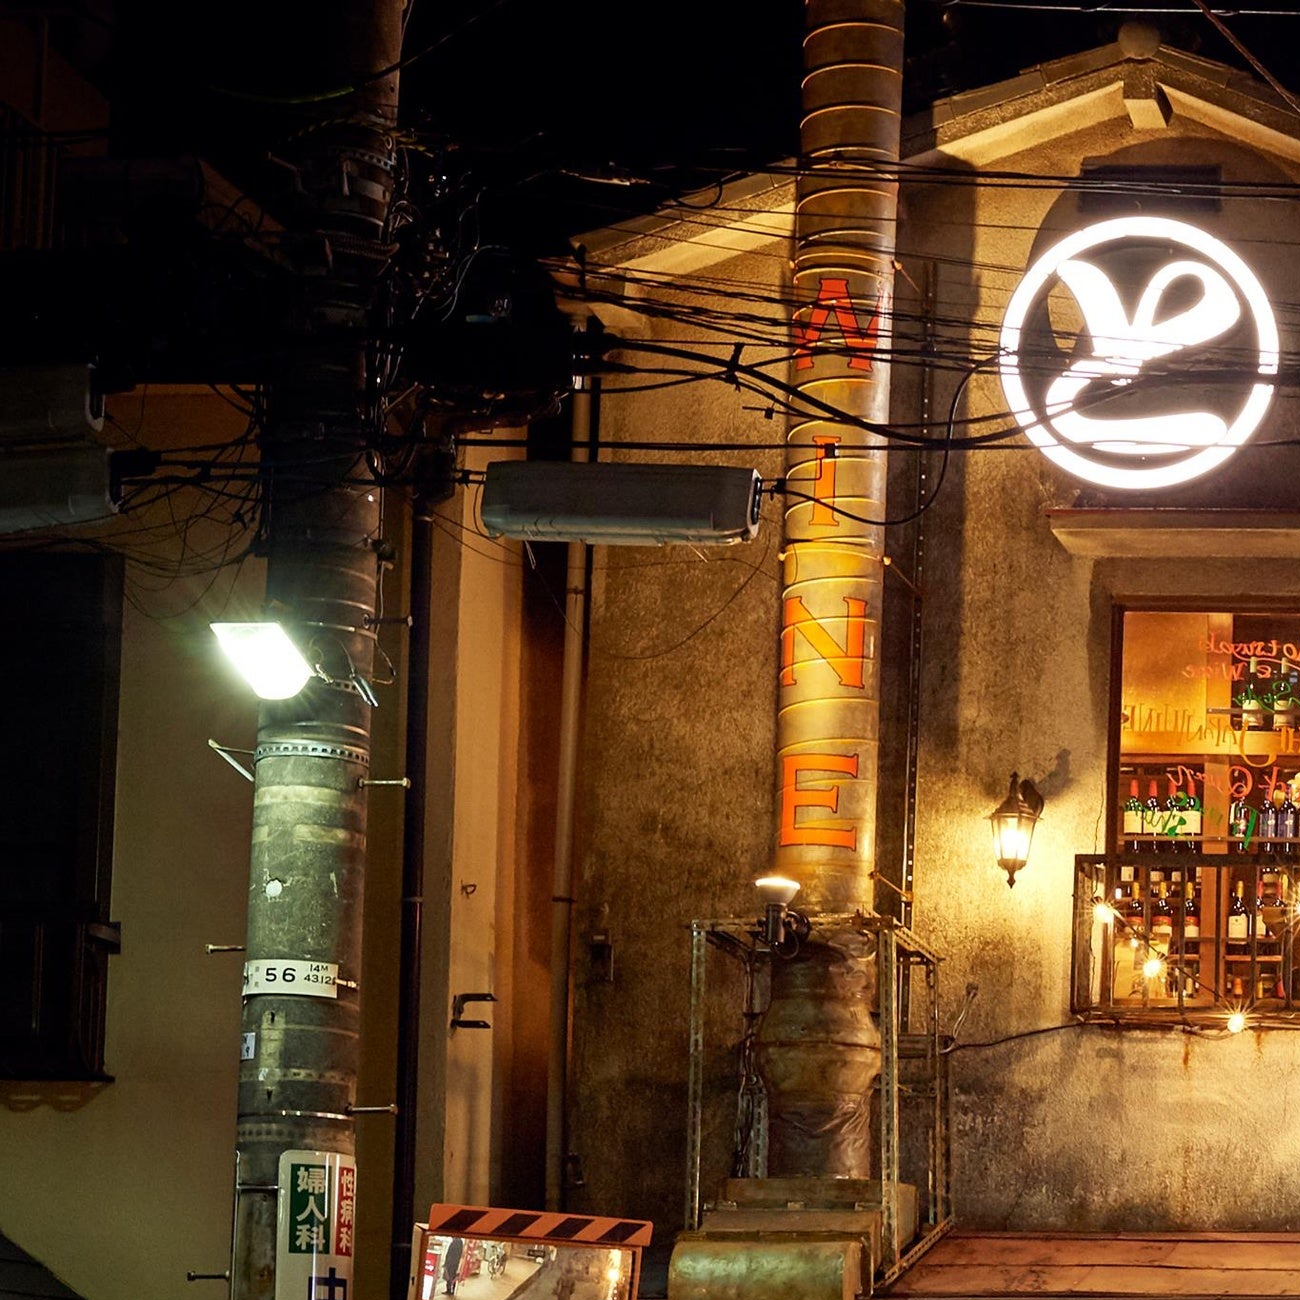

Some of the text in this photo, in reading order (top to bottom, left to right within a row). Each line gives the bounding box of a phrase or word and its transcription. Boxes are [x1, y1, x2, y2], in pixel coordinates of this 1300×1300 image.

[265, 967, 297, 983] 56
[296, 1166, 326, 1252] 婦人科
